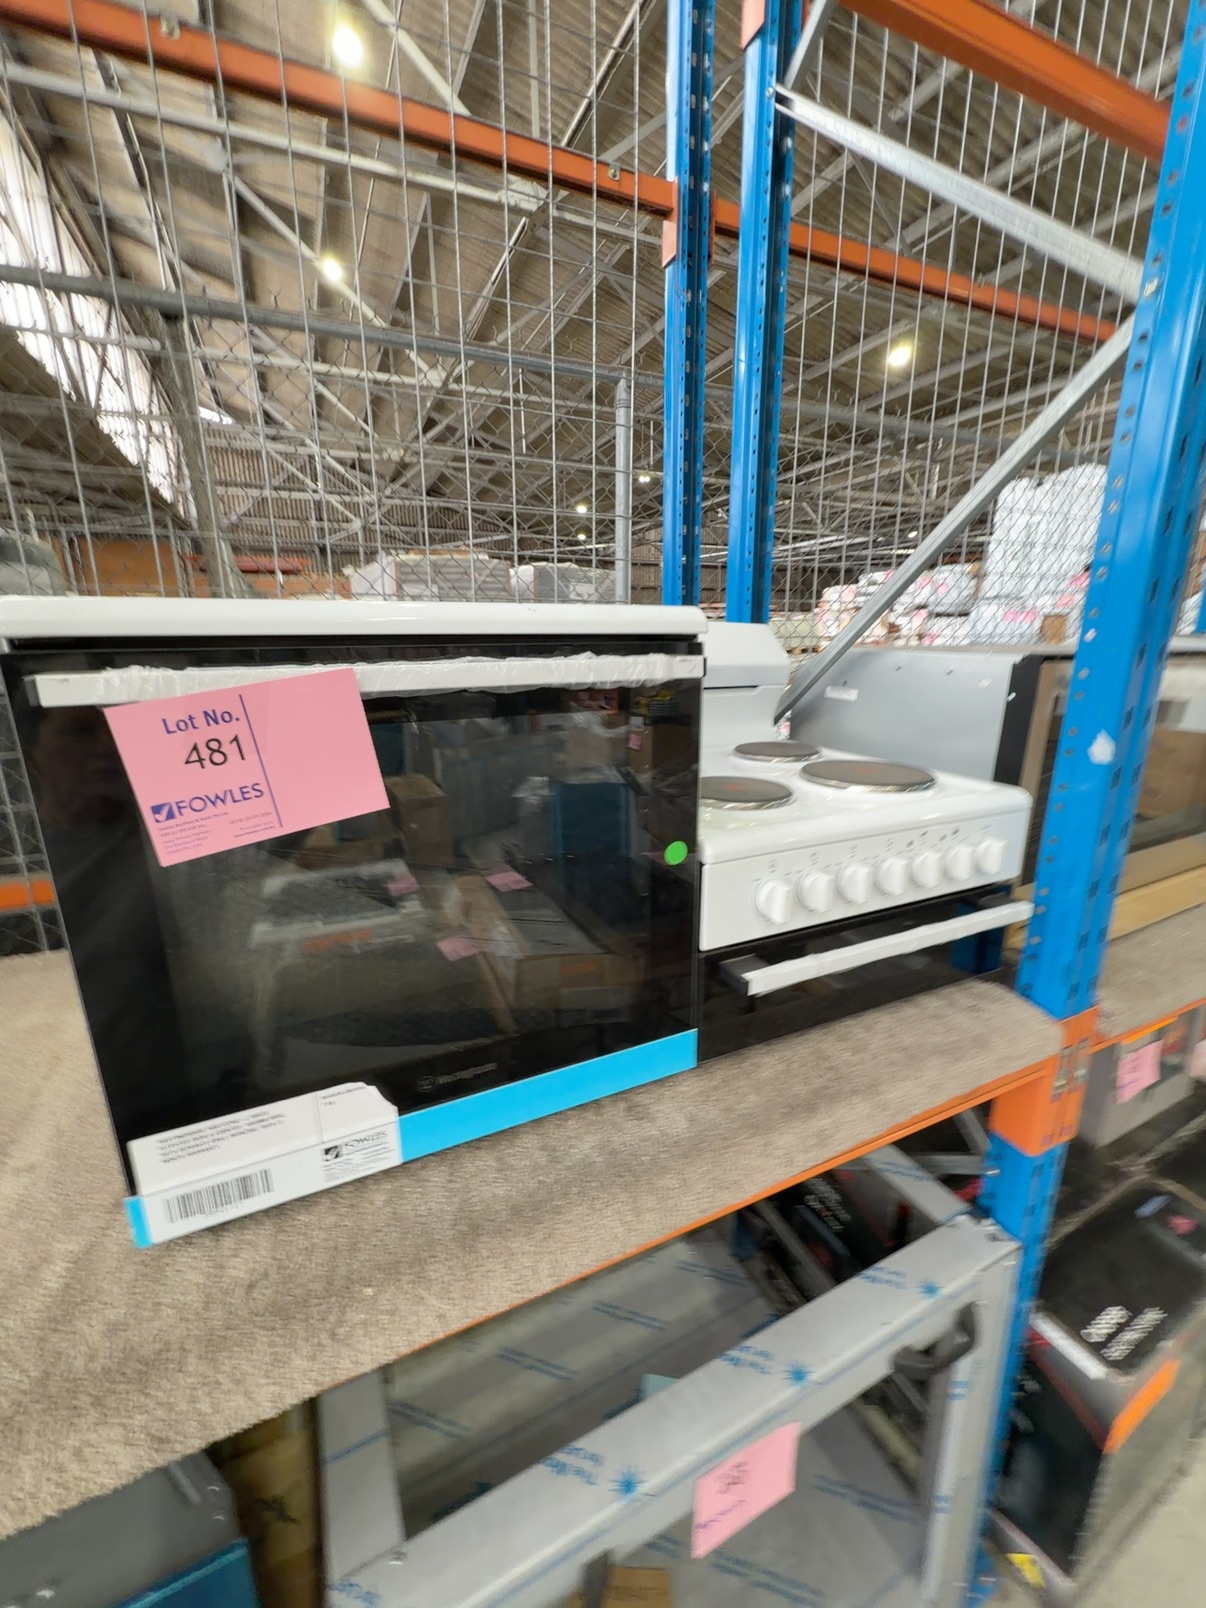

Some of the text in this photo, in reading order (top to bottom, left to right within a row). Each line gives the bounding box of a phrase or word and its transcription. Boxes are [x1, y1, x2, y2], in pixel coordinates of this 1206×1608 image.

[161, 709, 240, 735] Lot No.
[184, 734, 246, 769] 481
[175, 783, 264, 816] FOWLES
